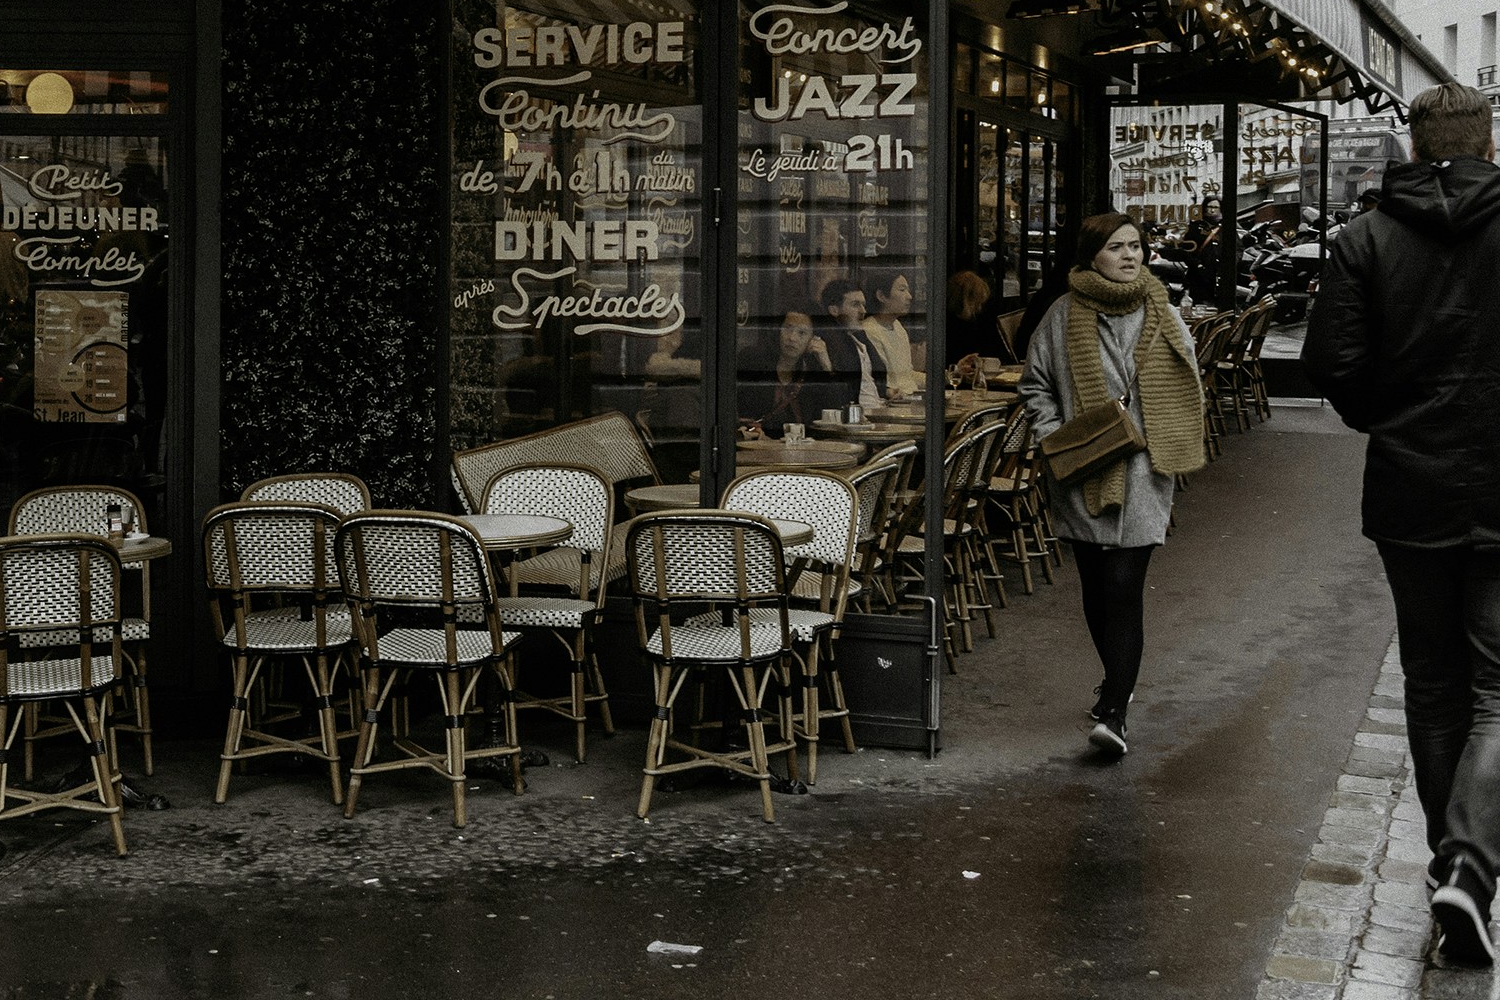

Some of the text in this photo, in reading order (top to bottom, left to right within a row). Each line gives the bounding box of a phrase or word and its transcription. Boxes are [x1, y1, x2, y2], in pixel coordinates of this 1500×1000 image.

[473, 20, 685, 69] SERVICE
[748, 0, 923, 64] Concert
[479, 69, 676, 146] Continu
[753, 72, 918, 121] JAZZ
[459, 159, 498, 195] de
[652, 149, 676, 165] du
[741, 148, 767, 178] Le
[766, 149, 820, 182] jeudi
[843, 134, 914, 172] 21h
[28, 163, 123, 200] Petit
[636, 171, 695, 192] matin
[14, 235, 145, 287] Complet
[495, 219, 659, 261] DINER
[453, 266, 686, 336] après Spectacles
[57, 408, 86, 423] Jean
